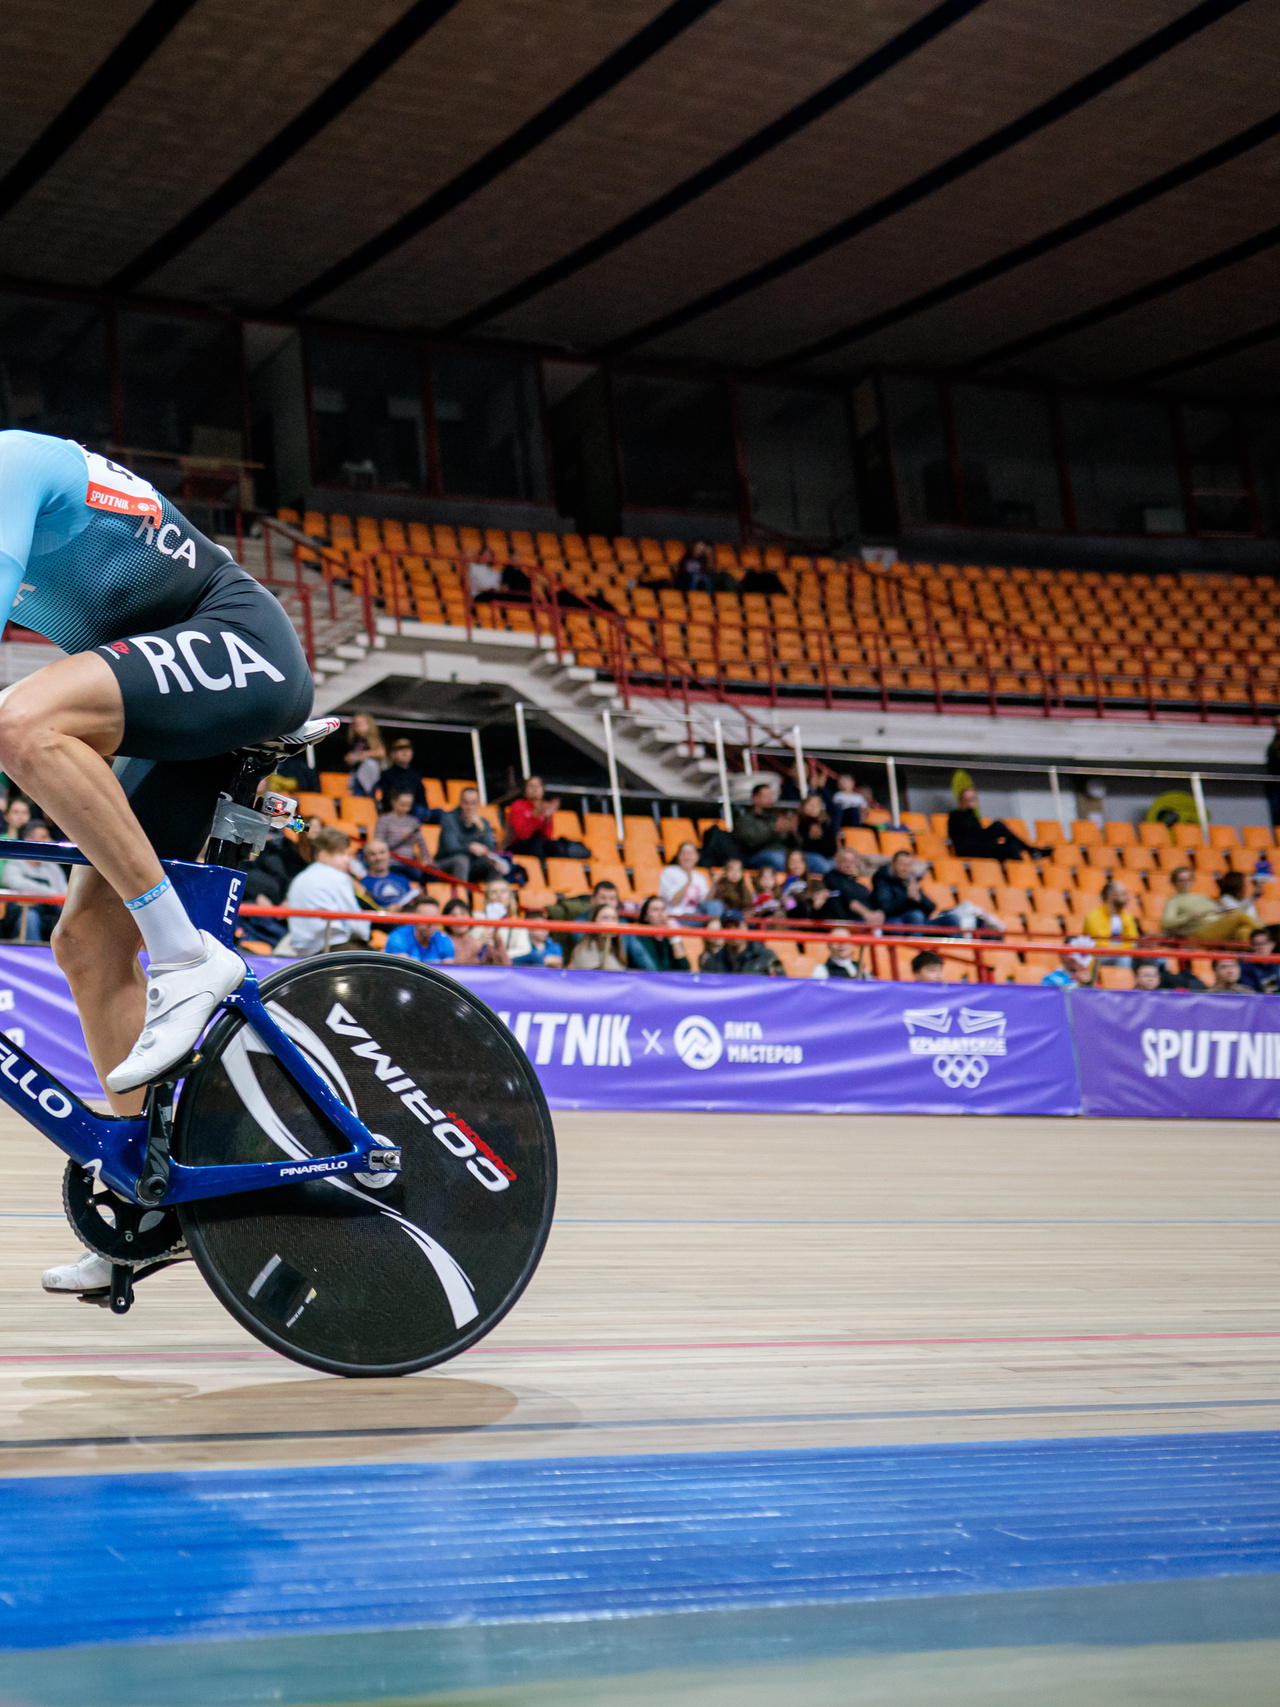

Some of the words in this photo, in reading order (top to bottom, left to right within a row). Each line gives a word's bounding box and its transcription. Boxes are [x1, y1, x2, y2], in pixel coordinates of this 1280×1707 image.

[90, 490, 130, 511] SPUTNIK
[128, 630, 286, 695] RCA
[222, 877, 242, 926] ITA
[498, 1011, 631, 1067] UTNIK
[723, 1020, 763, 1040] ЛИГА
[727, 1044, 804, 1065] МАСТЕРОВ
[325, 1002, 510, 1192] CORIMA
[280, 1160, 349, 1177] PINARELLO
